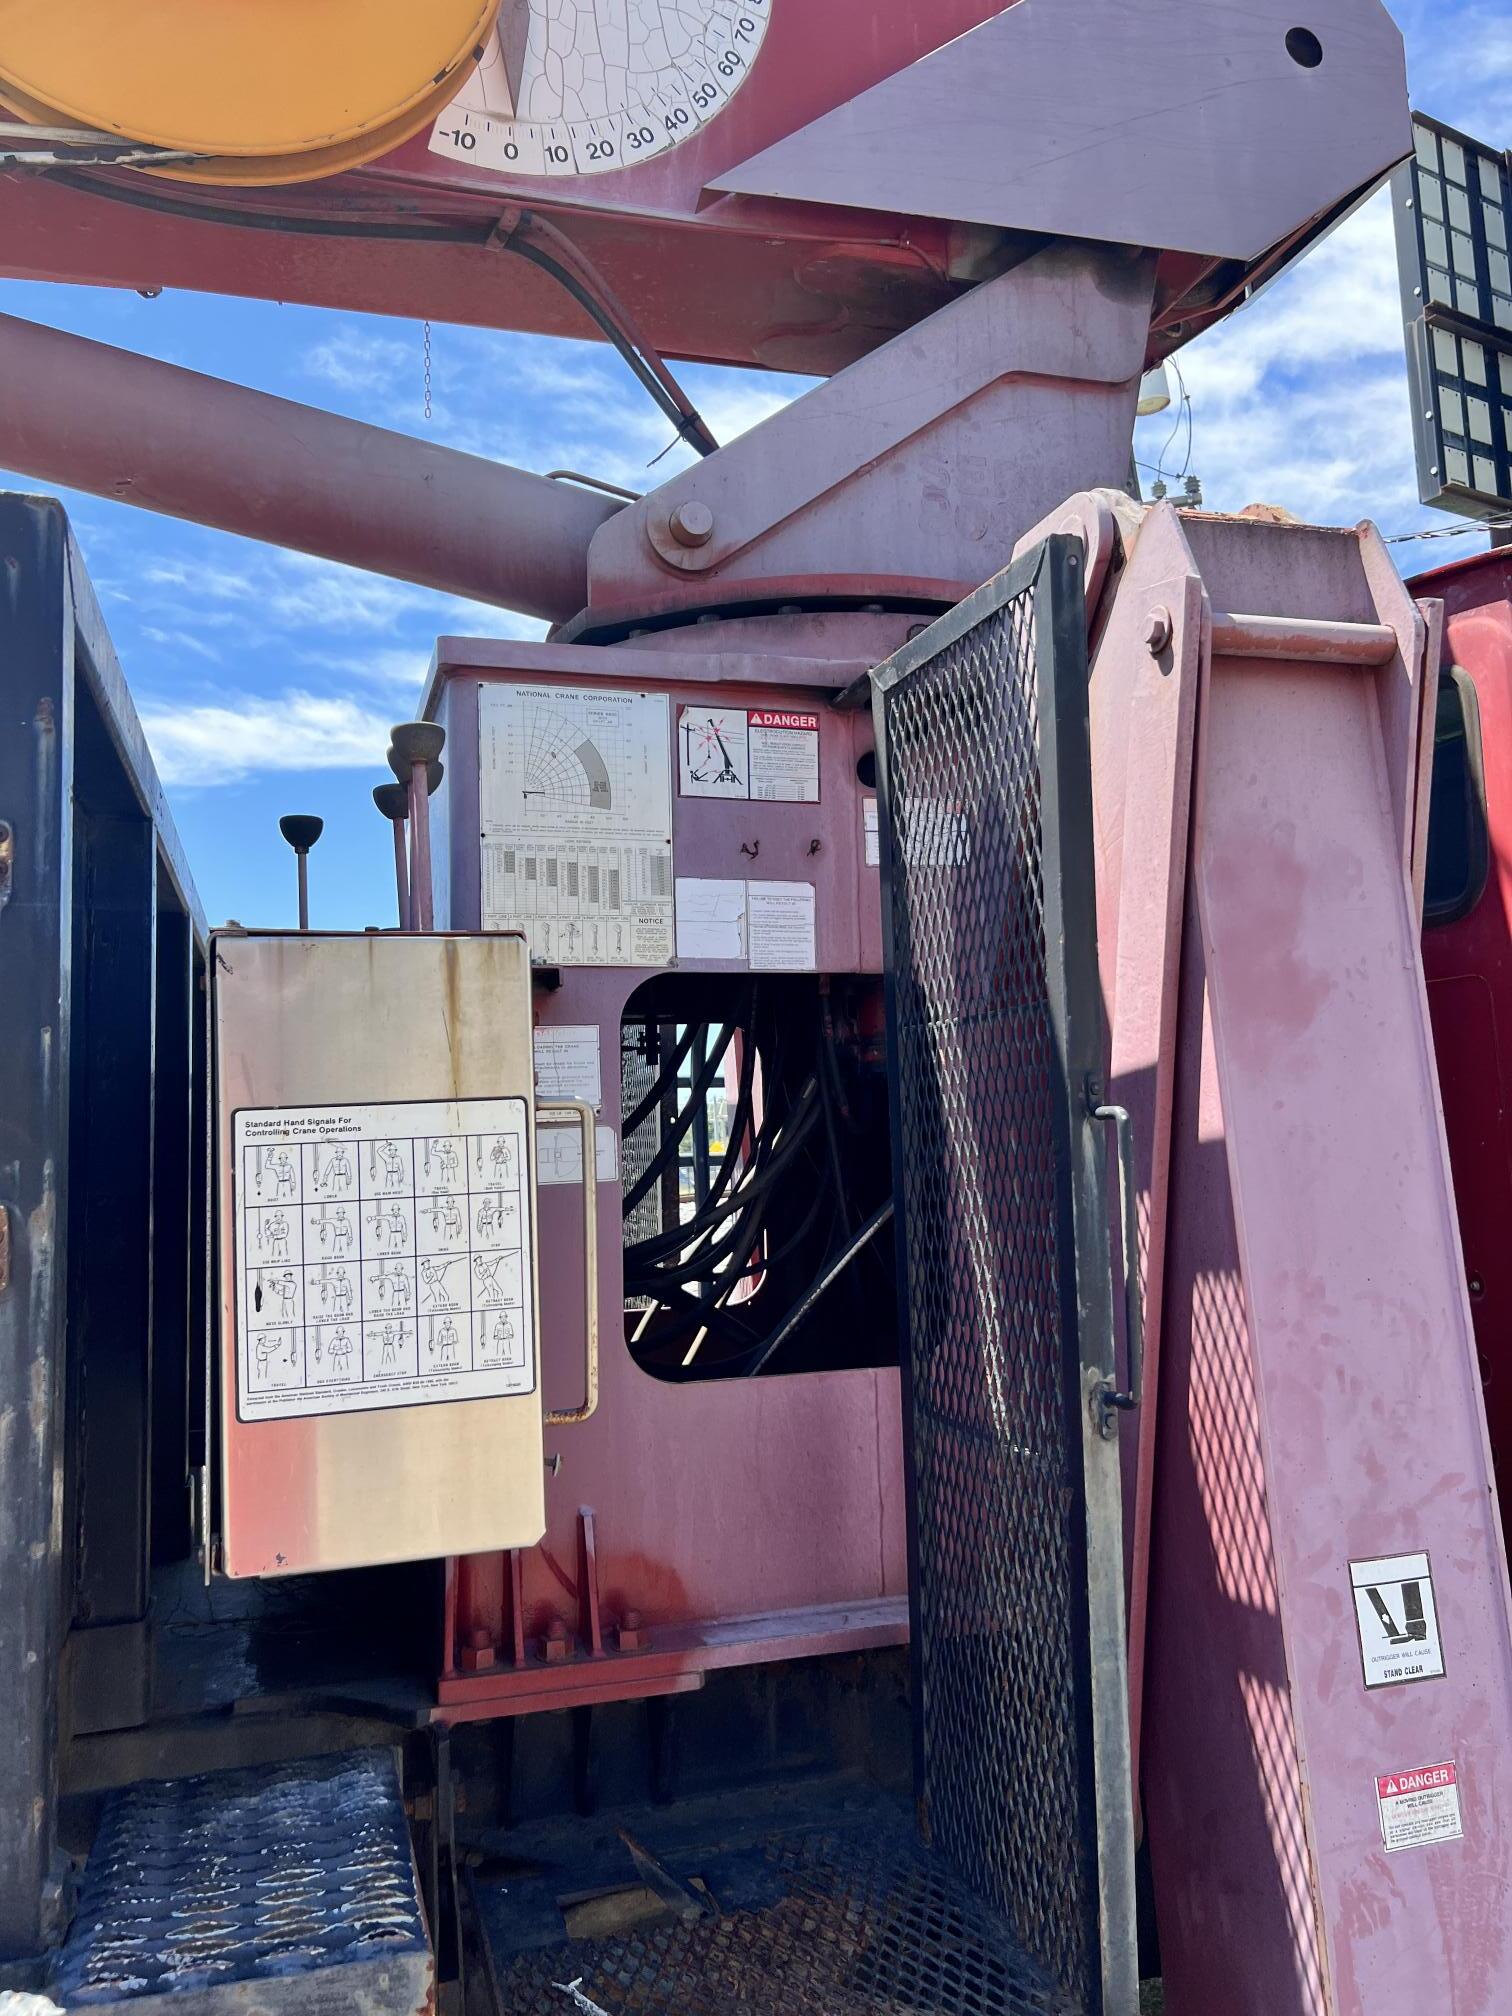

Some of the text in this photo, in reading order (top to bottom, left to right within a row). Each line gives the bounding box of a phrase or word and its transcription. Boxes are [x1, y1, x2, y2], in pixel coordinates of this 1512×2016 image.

[439, 17, 755, 163] -10 0 10 20 30 40 50 60 70
[516, 690, 633, 704] NATIONAL CRANE CORPORATION
[764, 713, 816, 728] DANGER
[638, 917, 664, 925] NOTICE
[245, 1116, 352, 1128] Standard Hand Signals For
[245, 1125, 362, 1137] Controlling Crane Operations
[1371, 1653, 1400, 1663] OUTRIGGER
[1414, 1648, 1432, 1656] CAUSE
[1383, 1668, 1403, 1679] STAND
[1404, 1664, 1424, 1675] CLEAR
[1399, 1769, 1449, 1790] DANGER
[1418, 1791, 1444, 1800] OUTRIGGER
